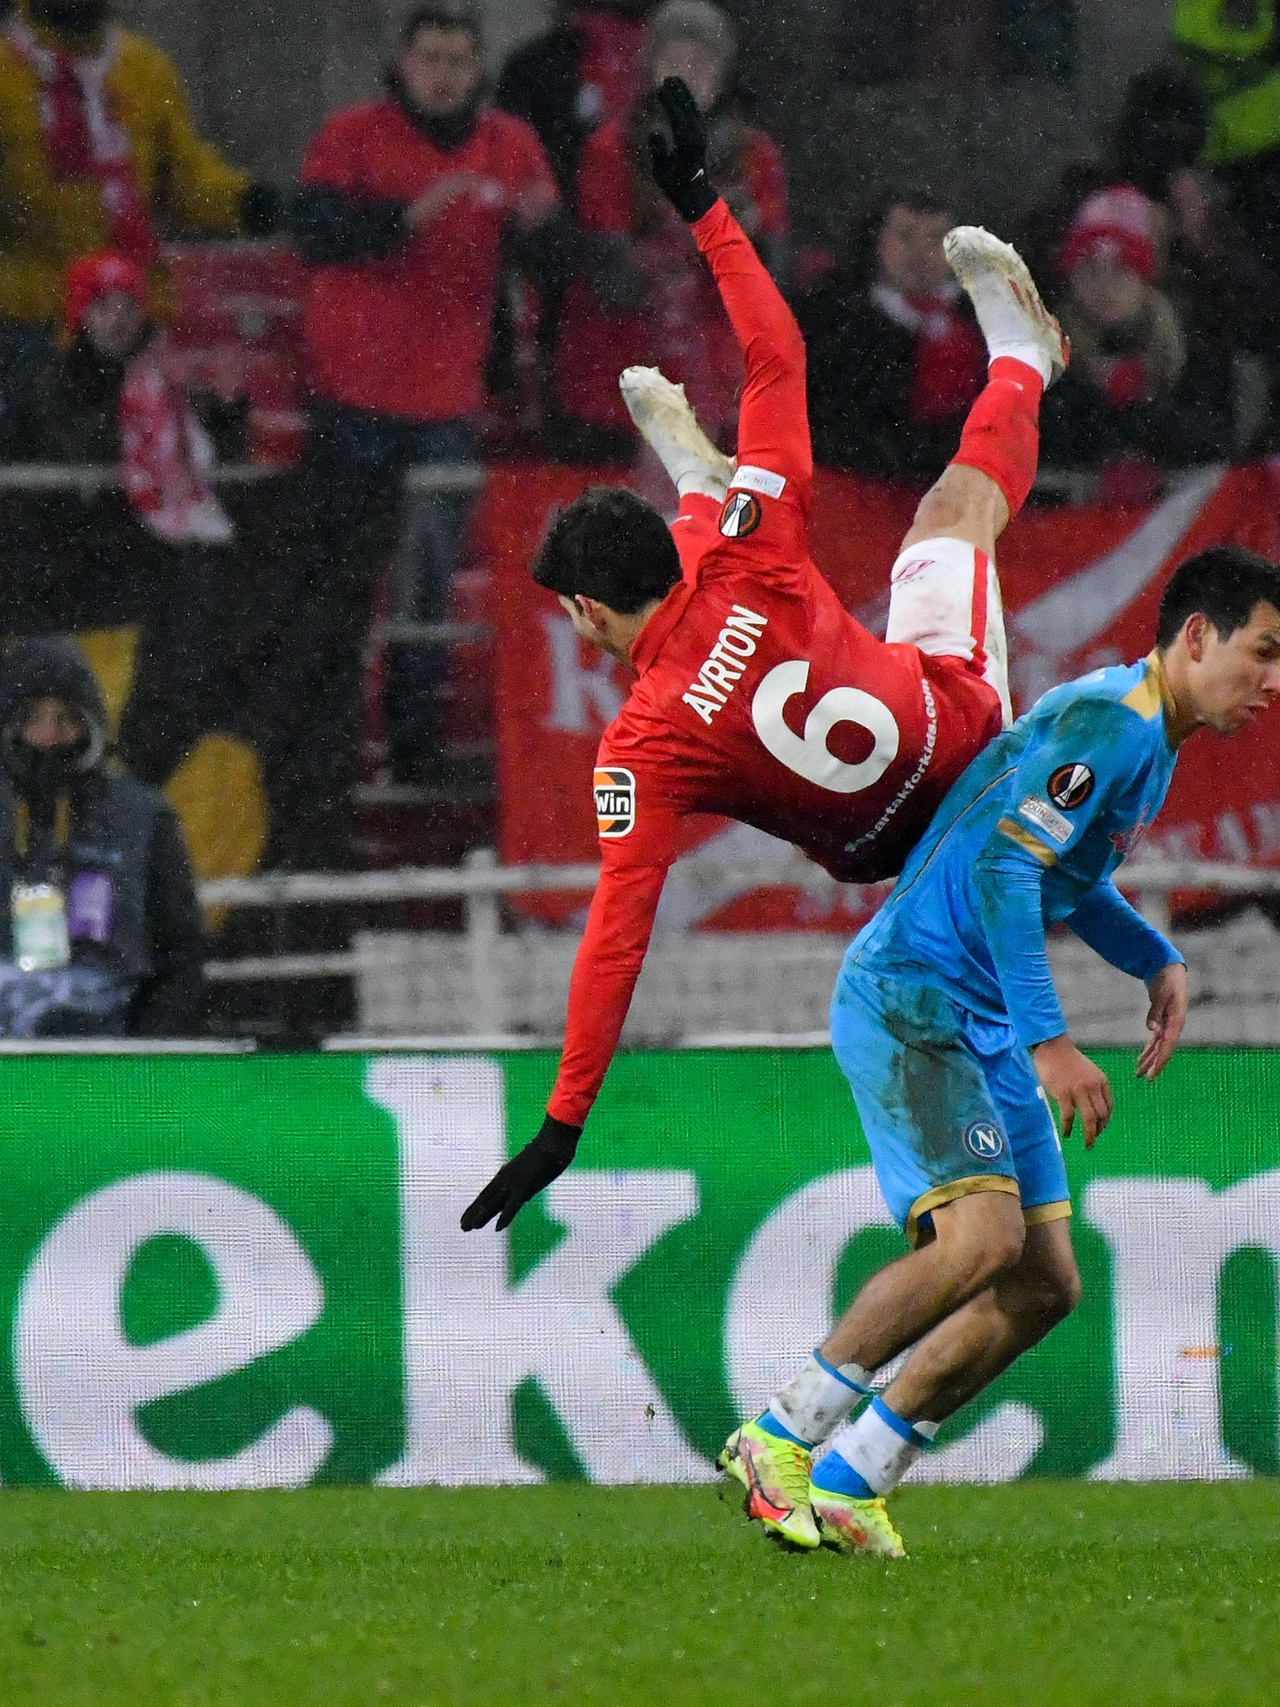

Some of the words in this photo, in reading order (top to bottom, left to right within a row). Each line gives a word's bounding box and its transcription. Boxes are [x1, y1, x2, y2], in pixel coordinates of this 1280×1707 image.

[682, 604, 768, 725] AYRTON
[752, 660, 900, 793] 6
[976, 1130, 996, 1151] N
